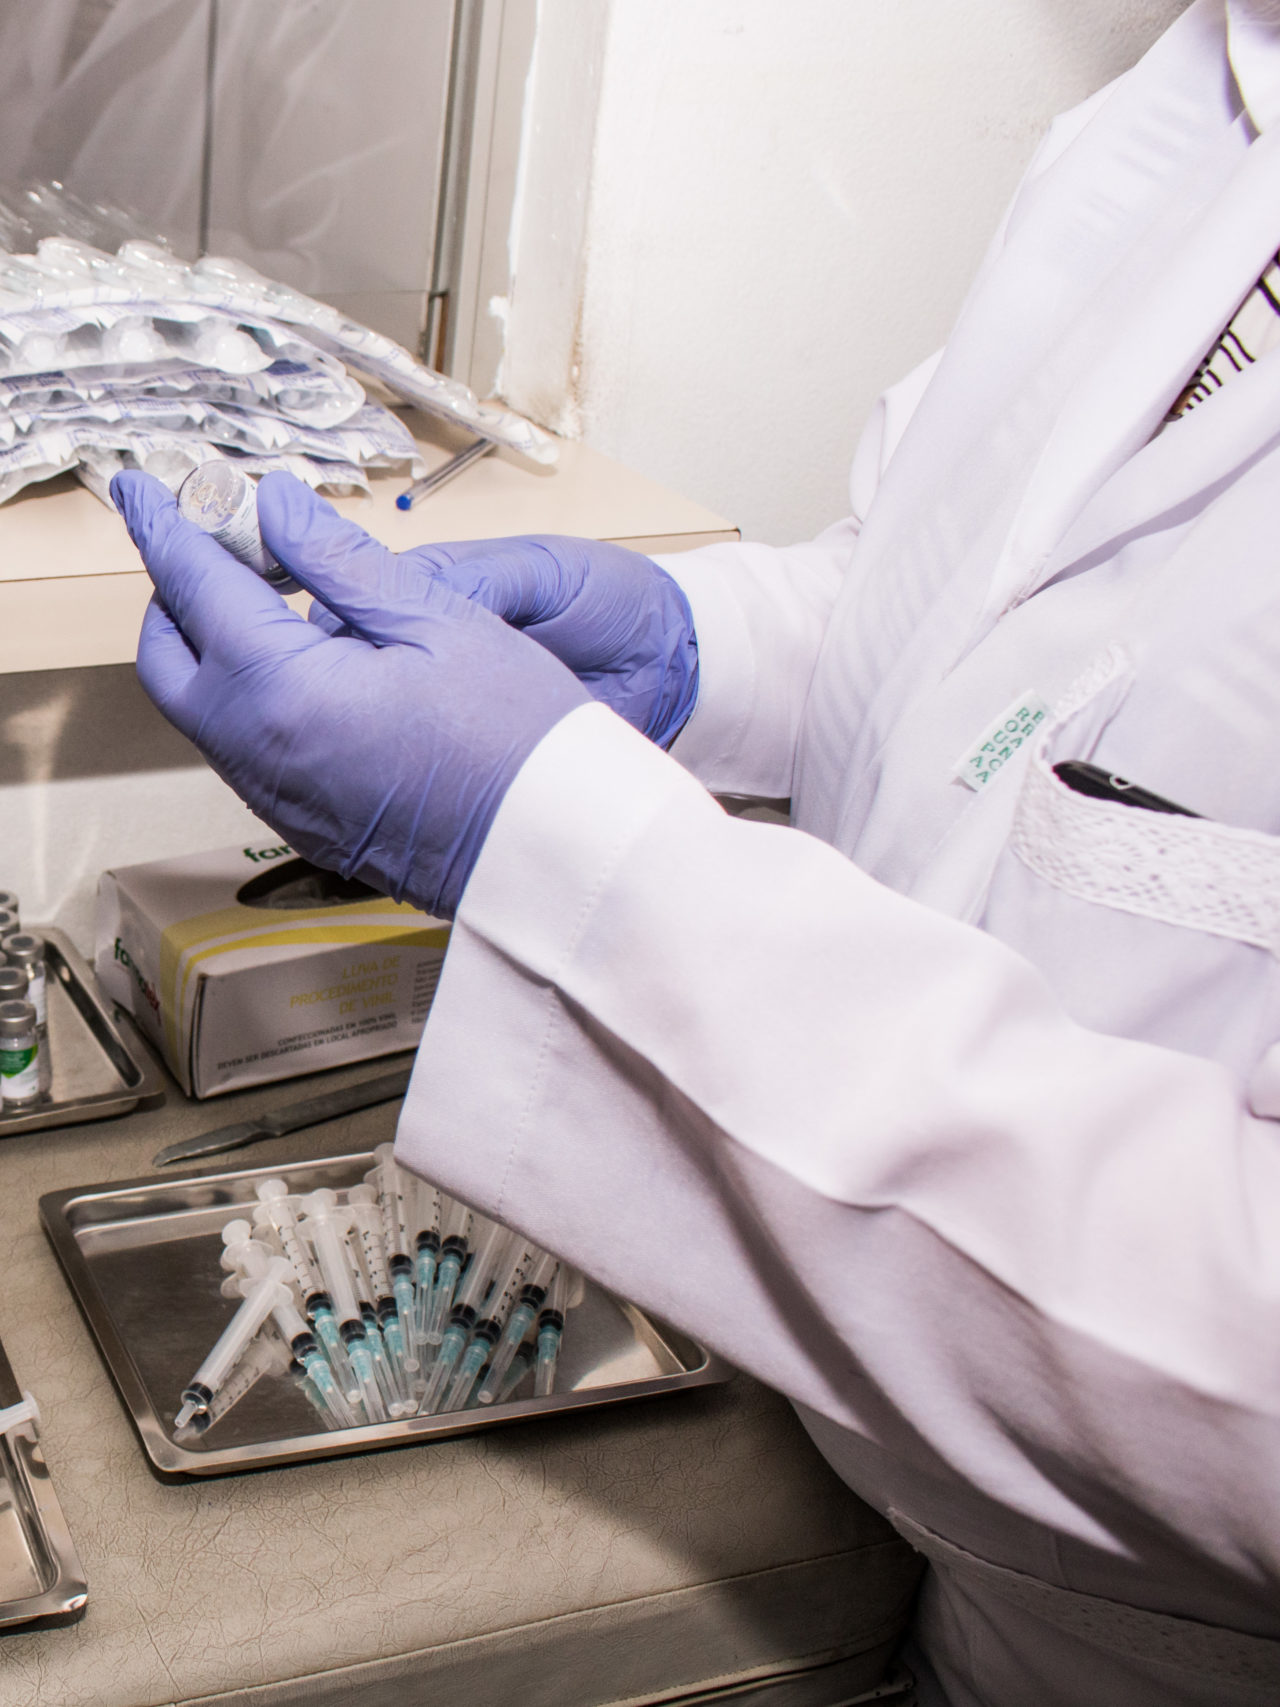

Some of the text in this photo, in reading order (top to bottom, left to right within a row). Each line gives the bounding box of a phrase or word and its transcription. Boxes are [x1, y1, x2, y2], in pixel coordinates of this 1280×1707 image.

[382, 955, 401, 971] DE
[289, 973, 399, 1008] PROCEDIMENTO
[339, 1001, 356, 1015] DE
